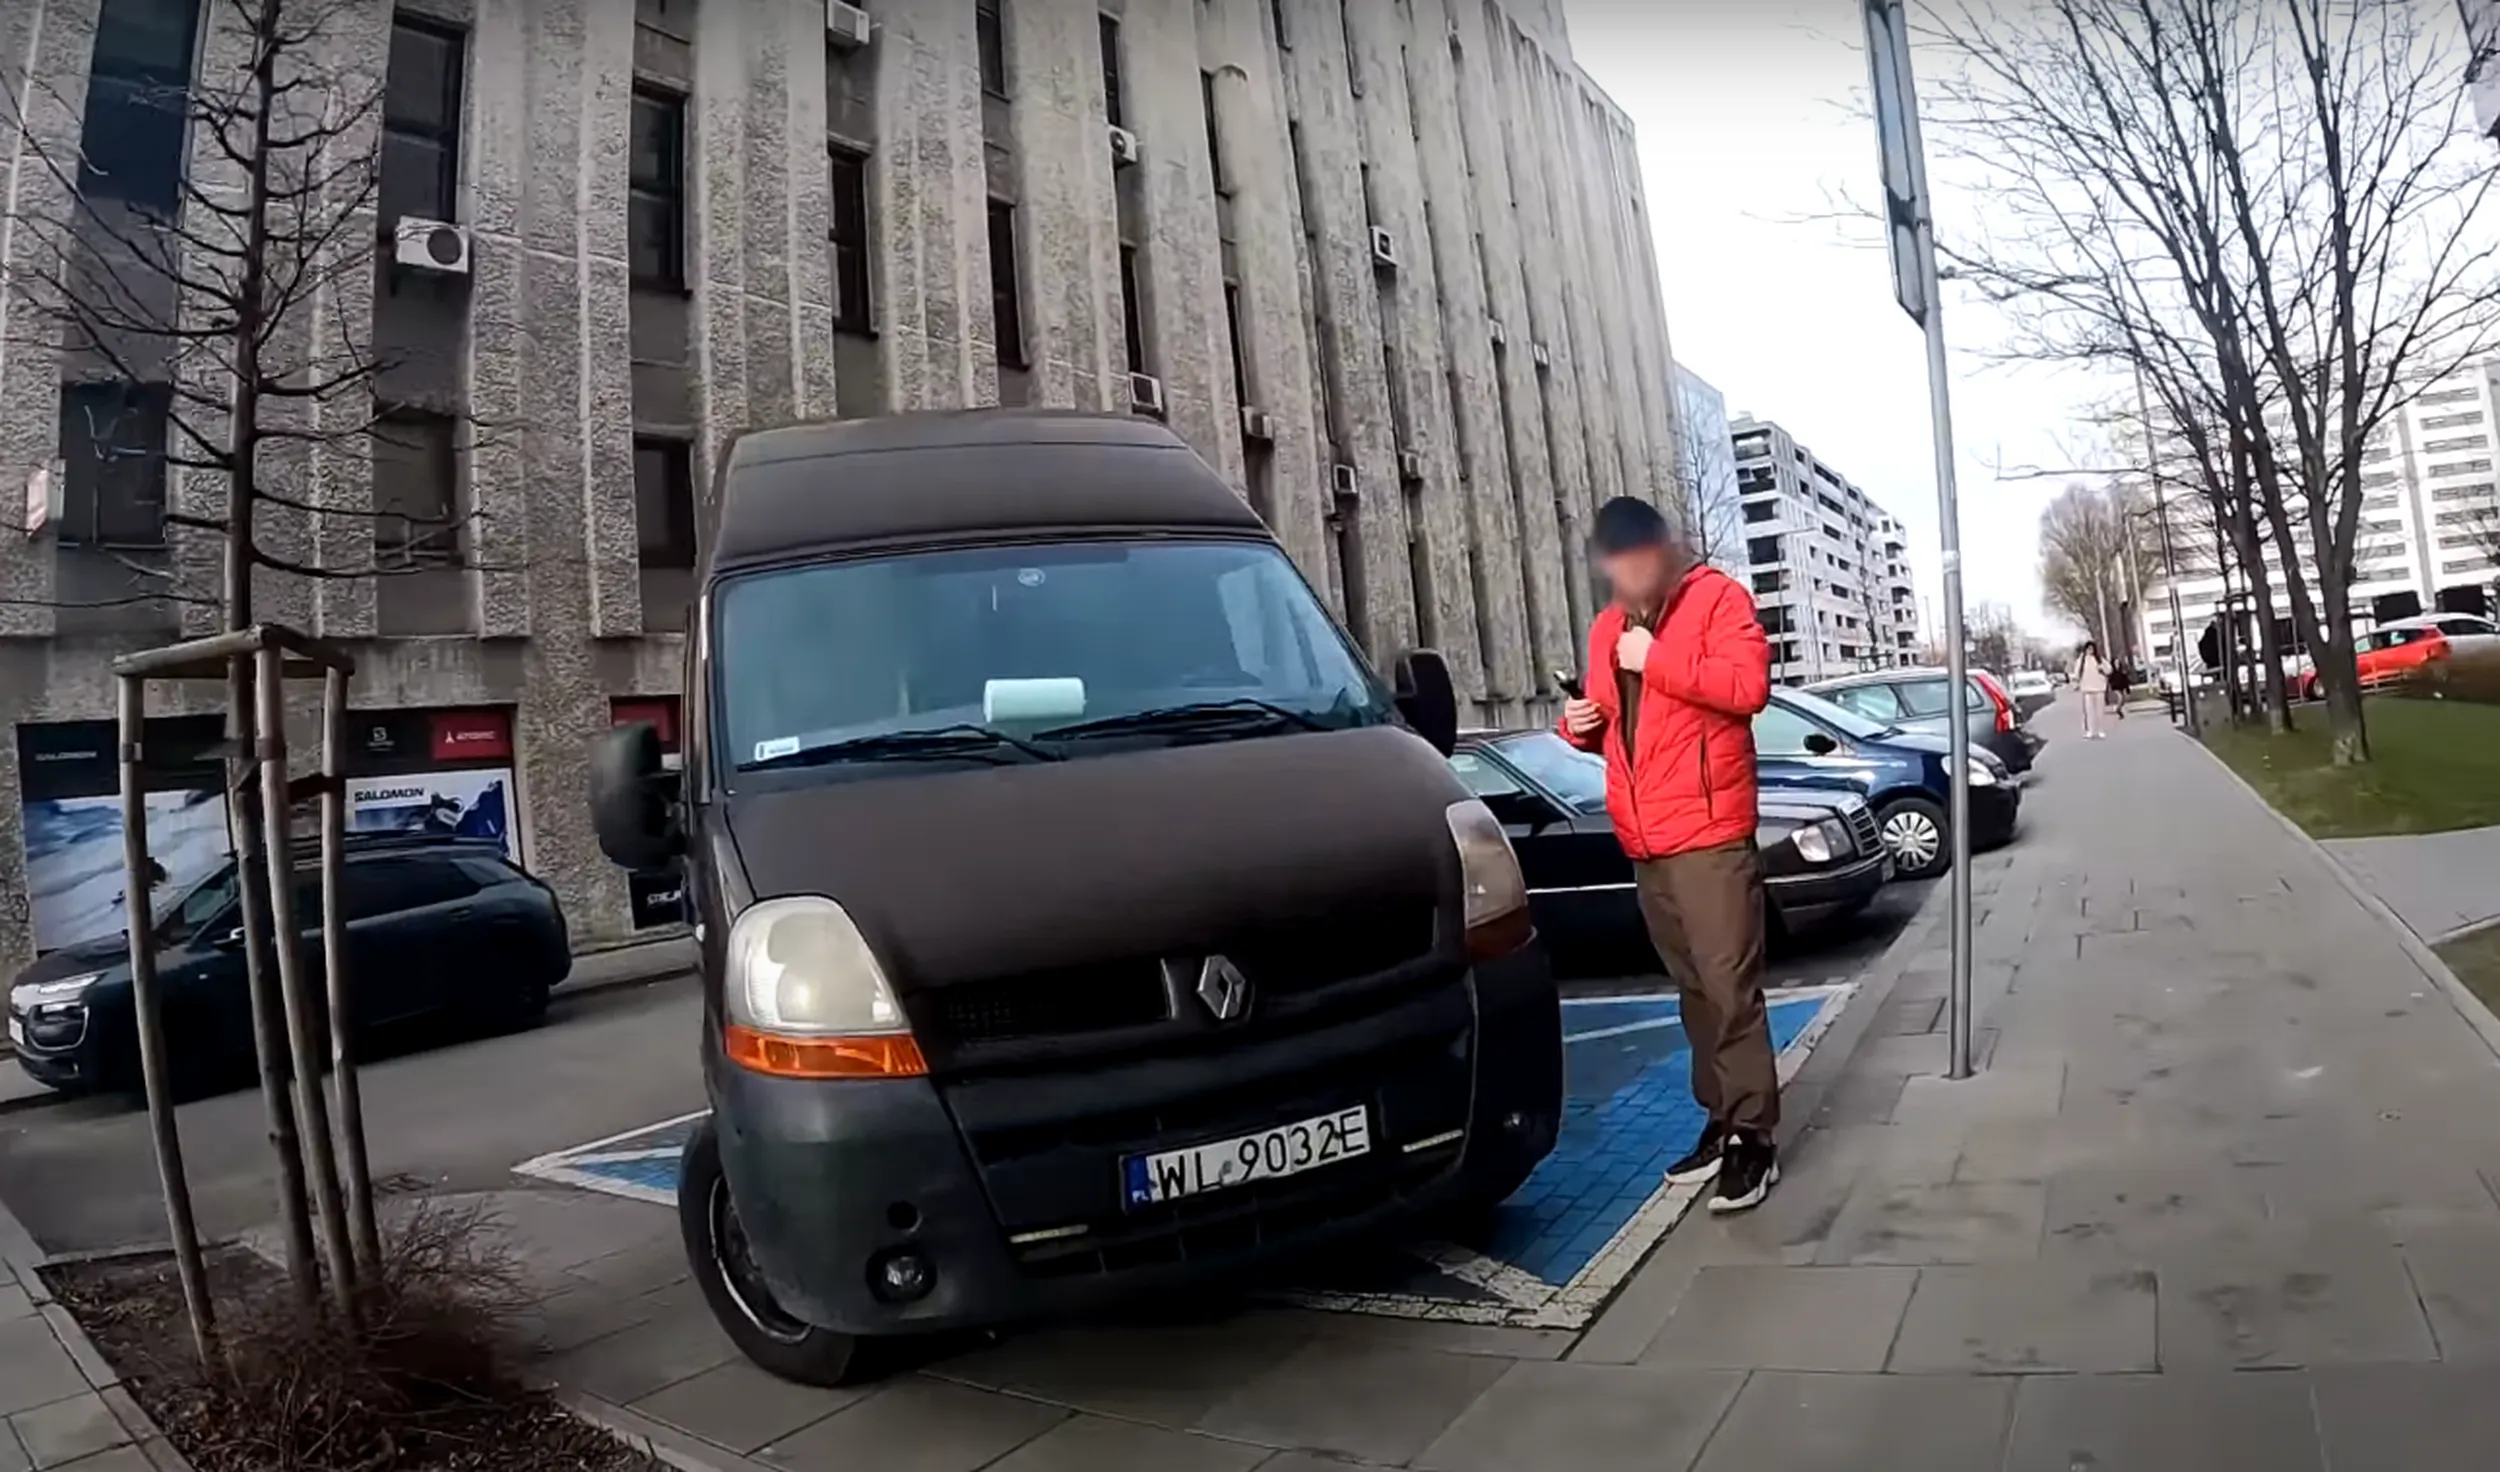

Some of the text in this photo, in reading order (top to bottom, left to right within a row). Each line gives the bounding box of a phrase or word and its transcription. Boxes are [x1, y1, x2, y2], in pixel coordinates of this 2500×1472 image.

[354, 787, 425, 803] SALOMON
[1156, 1109, 1366, 1200] WL 9032E
